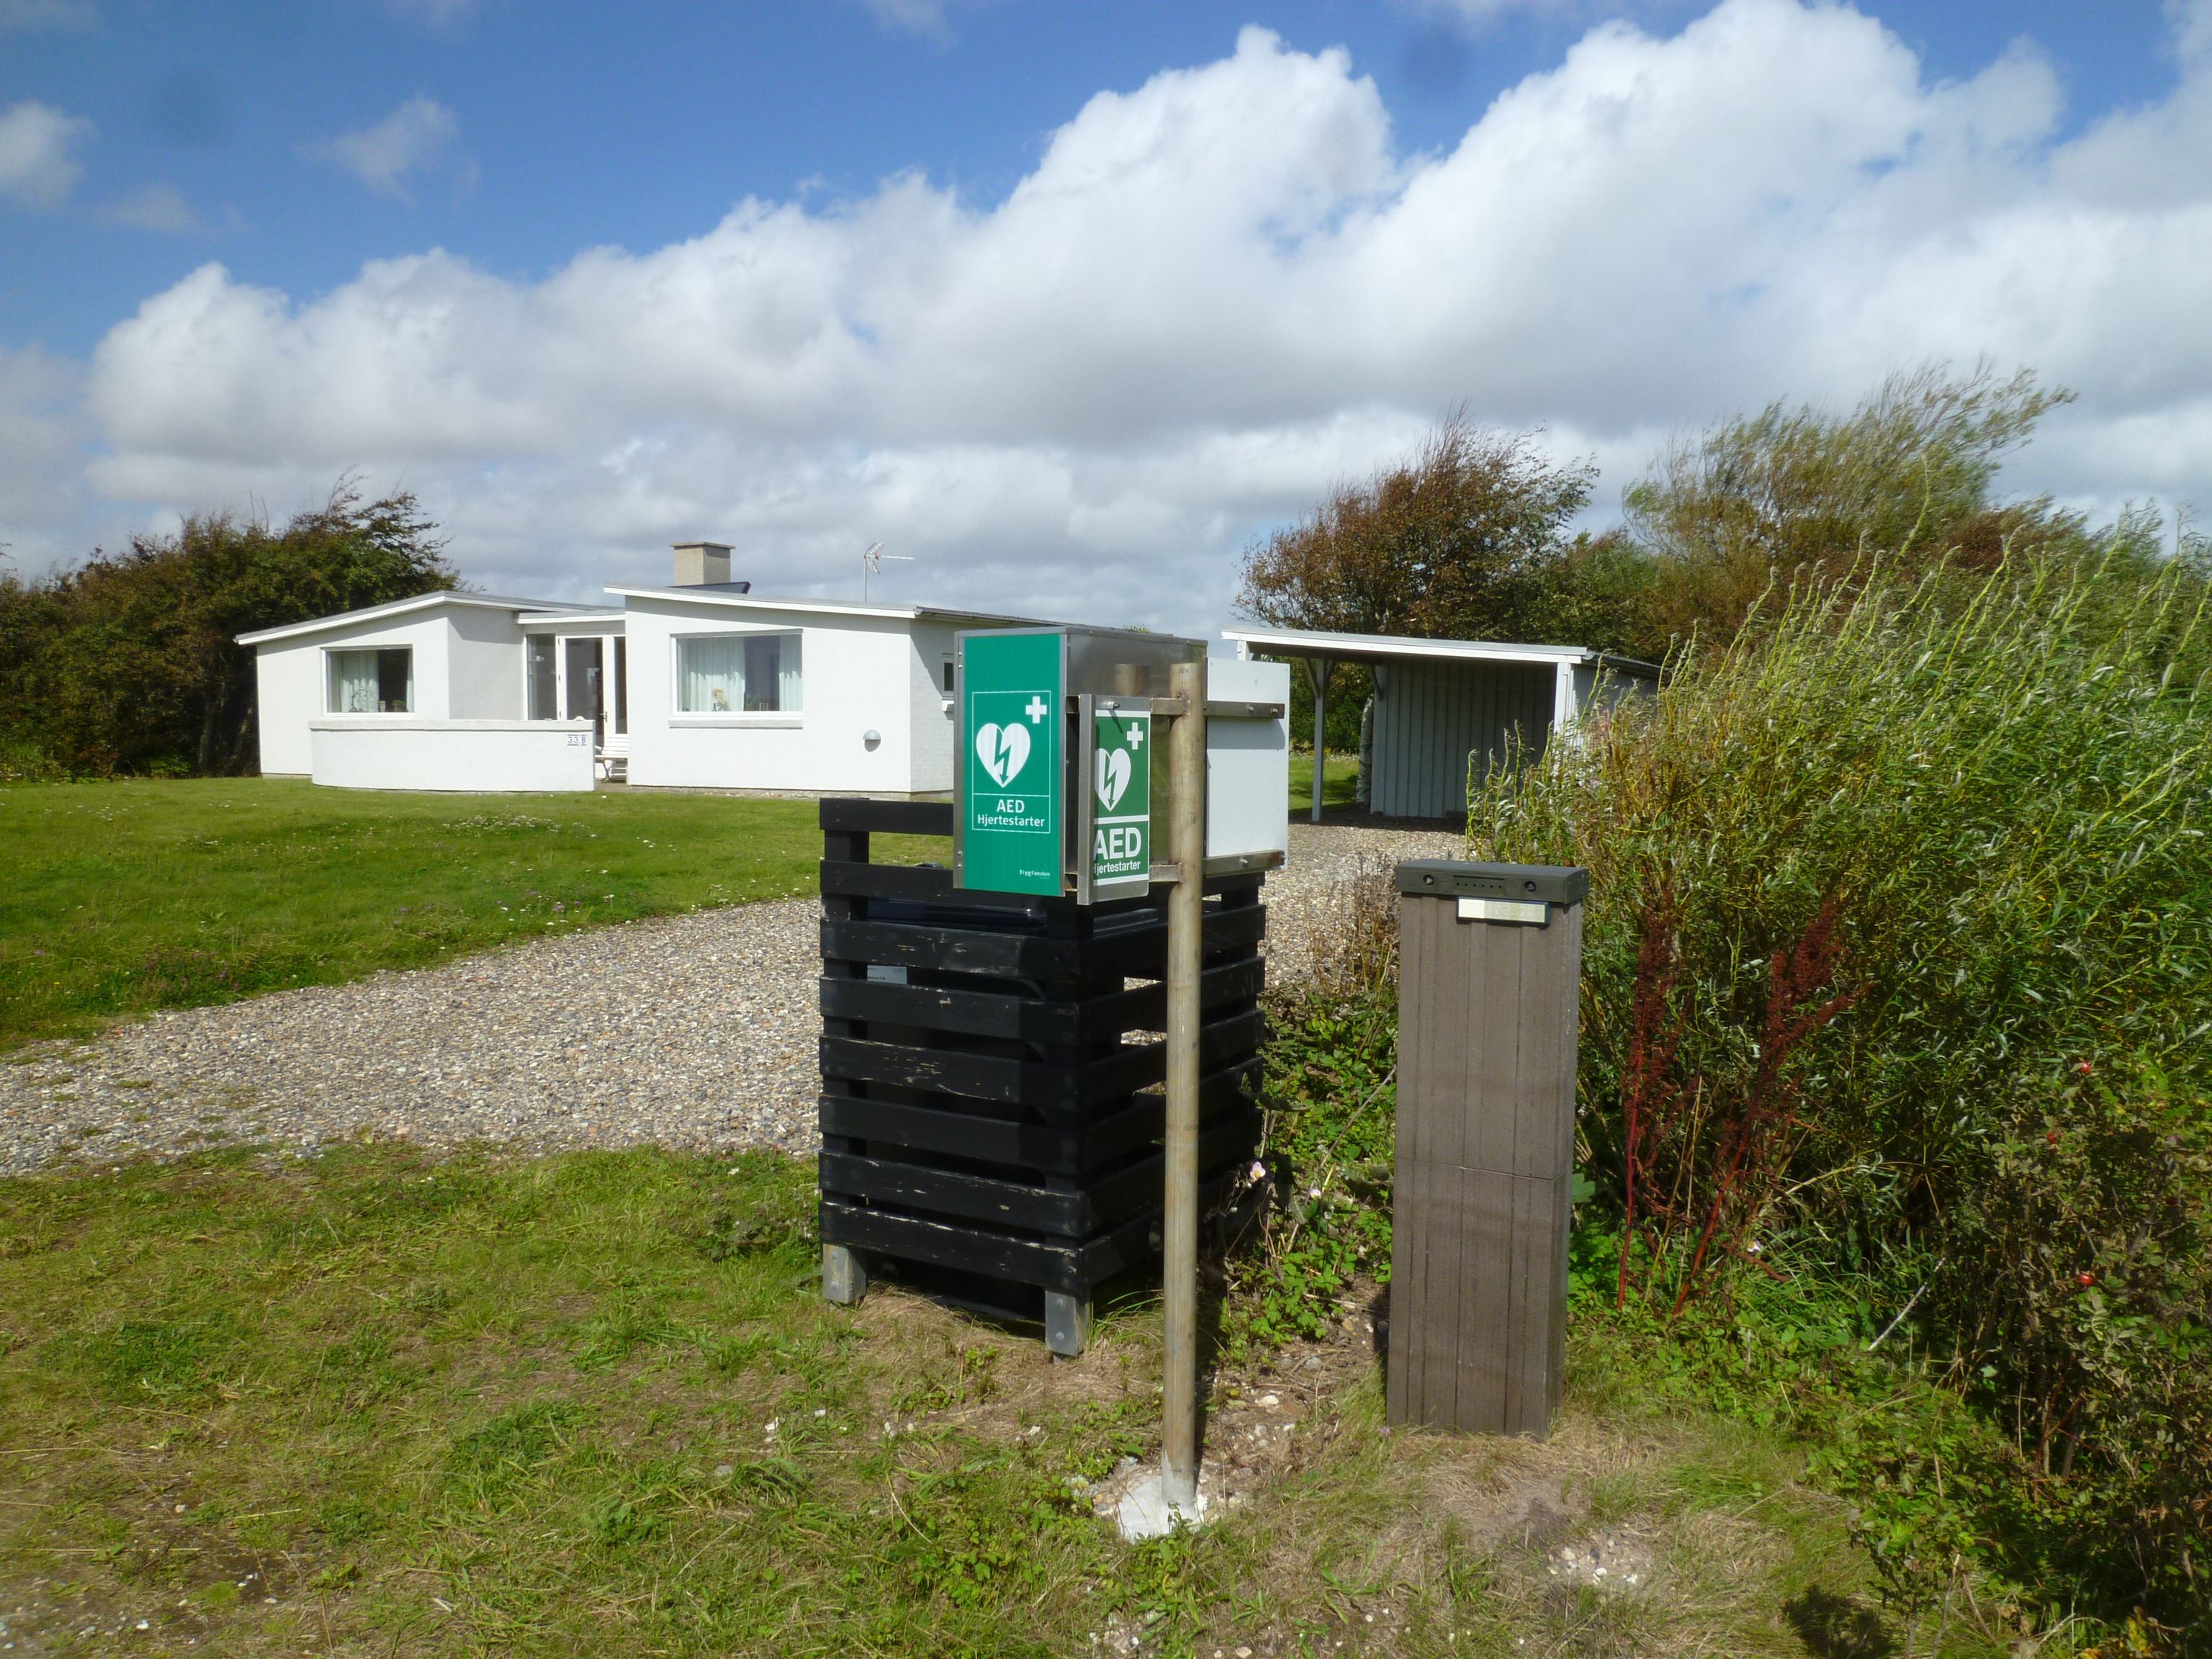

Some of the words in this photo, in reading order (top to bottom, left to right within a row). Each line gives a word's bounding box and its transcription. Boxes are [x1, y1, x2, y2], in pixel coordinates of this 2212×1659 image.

[996, 799, 1025, 813] AED
[978, 814, 1045, 827] Hjertestarter
[1094, 827, 1141, 860] AED
